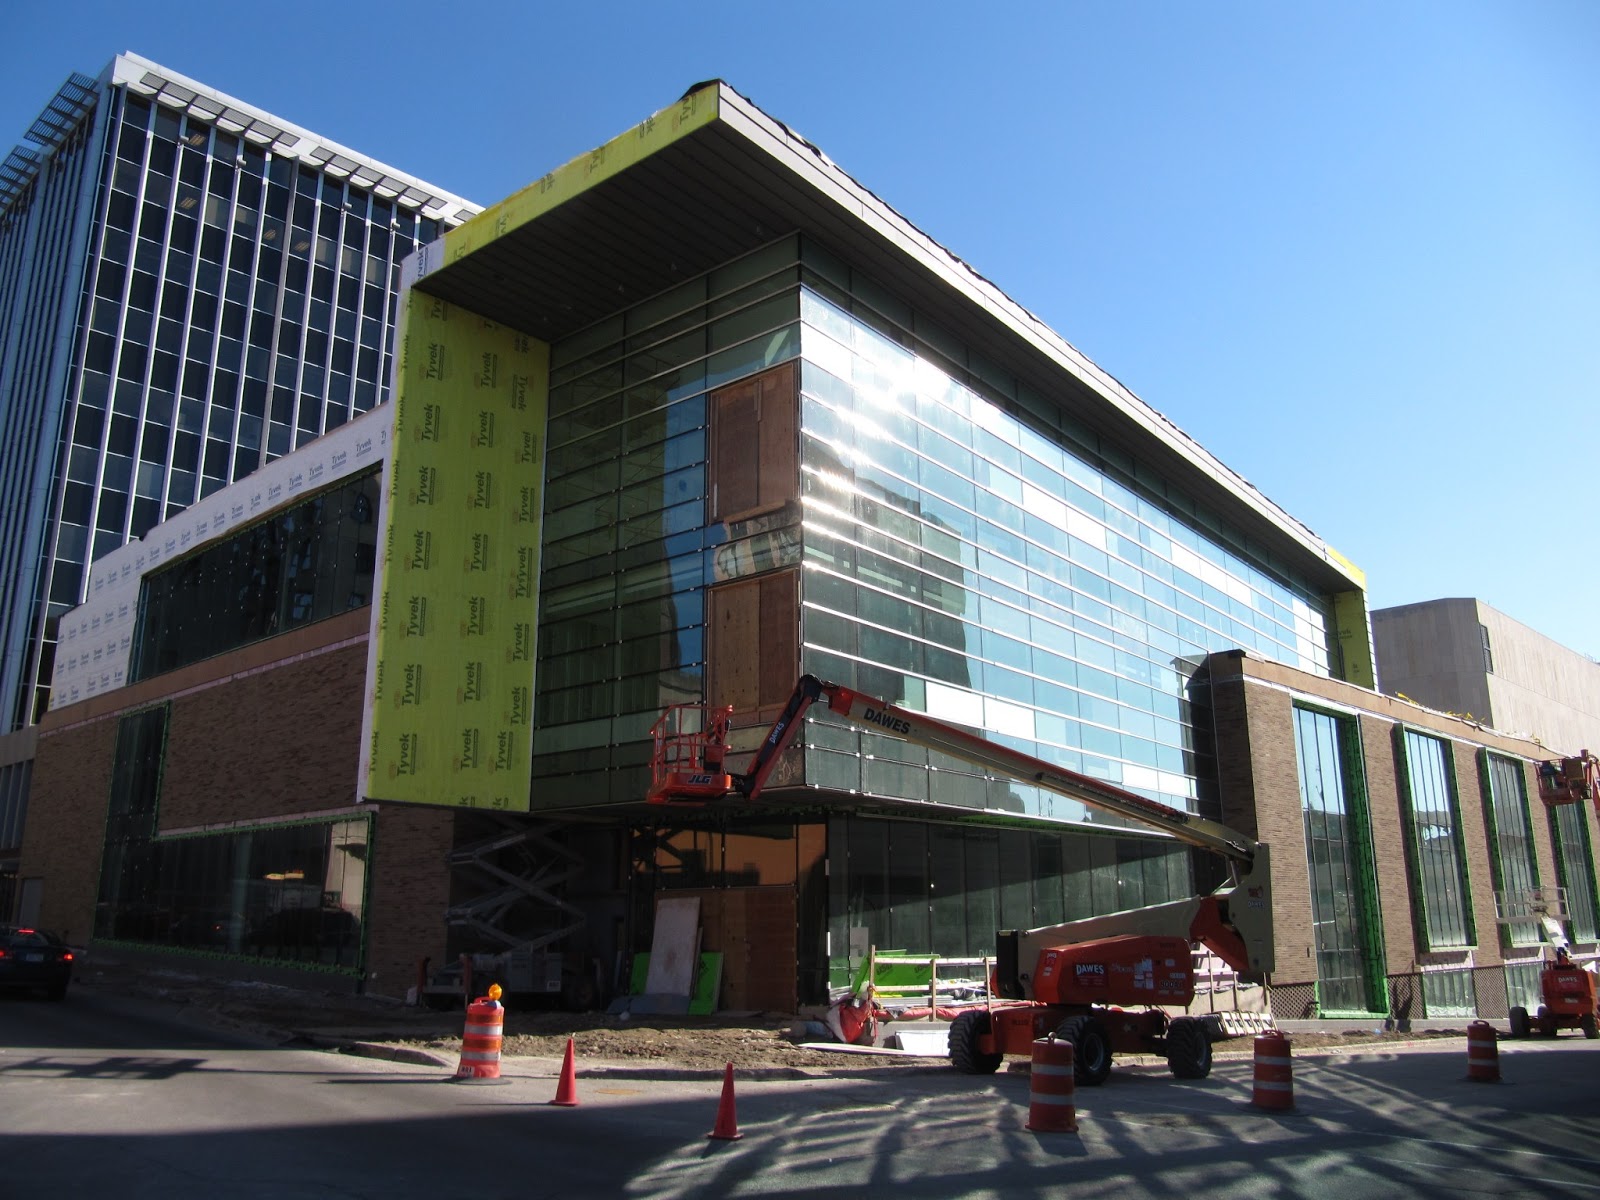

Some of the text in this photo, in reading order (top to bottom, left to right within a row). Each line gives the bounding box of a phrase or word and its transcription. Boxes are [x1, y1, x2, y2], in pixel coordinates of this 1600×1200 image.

[426, 342, 438, 380] Tyvek
[480, 351, 491, 388] Tyvek
[518, 376, 528, 411] Tyvek
[396, 395, 406, 432] Tyvek
[421, 403, 434, 441] Tyvek
[477, 410, 488, 448] Tyvek
[331, 451, 347, 464] Tyvek
[356, 438, 372, 452] Tyvek
[289, 473, 303, 485] Tyvek
[309, 463, 323, 476] Tyvek
[391, 459, 400, 497] Tyvek
[416, 465, 429, 505] Tyvek
[473, 470, 485, 508] Tyvek
[518, 486, 529, 524] Tyvek
[411, 529, 425, 570] Tyvek
[470, 532, 482, 571] Tyvek
[380, 591, 390, 631] Tyvek
[406, 595, 420, 637] Tyvek
[467, 595, 479, 637] Tyvek
[512, 622, 523, 662] Tyvek
[374, 660, 385, 700] Tyvek
[401, 663, 415, 706] Tyvek
[463, 661, 476, 702] Tyvek
[510, 686, 521, 725] Tyvek
[864, 707, 911, 734] DAWES
[368, 730, 379, 773] Tyvek
[460, 728, 473, 771] Tyvek
[495, 730, 507, 771] Tyvek
[769, 721, 785, 745] DAWES
[397, 732, 410, 776] Tyvek
[688, 774, 712, 785] JLG
[1076, 964, 1105, 975] DAWES
